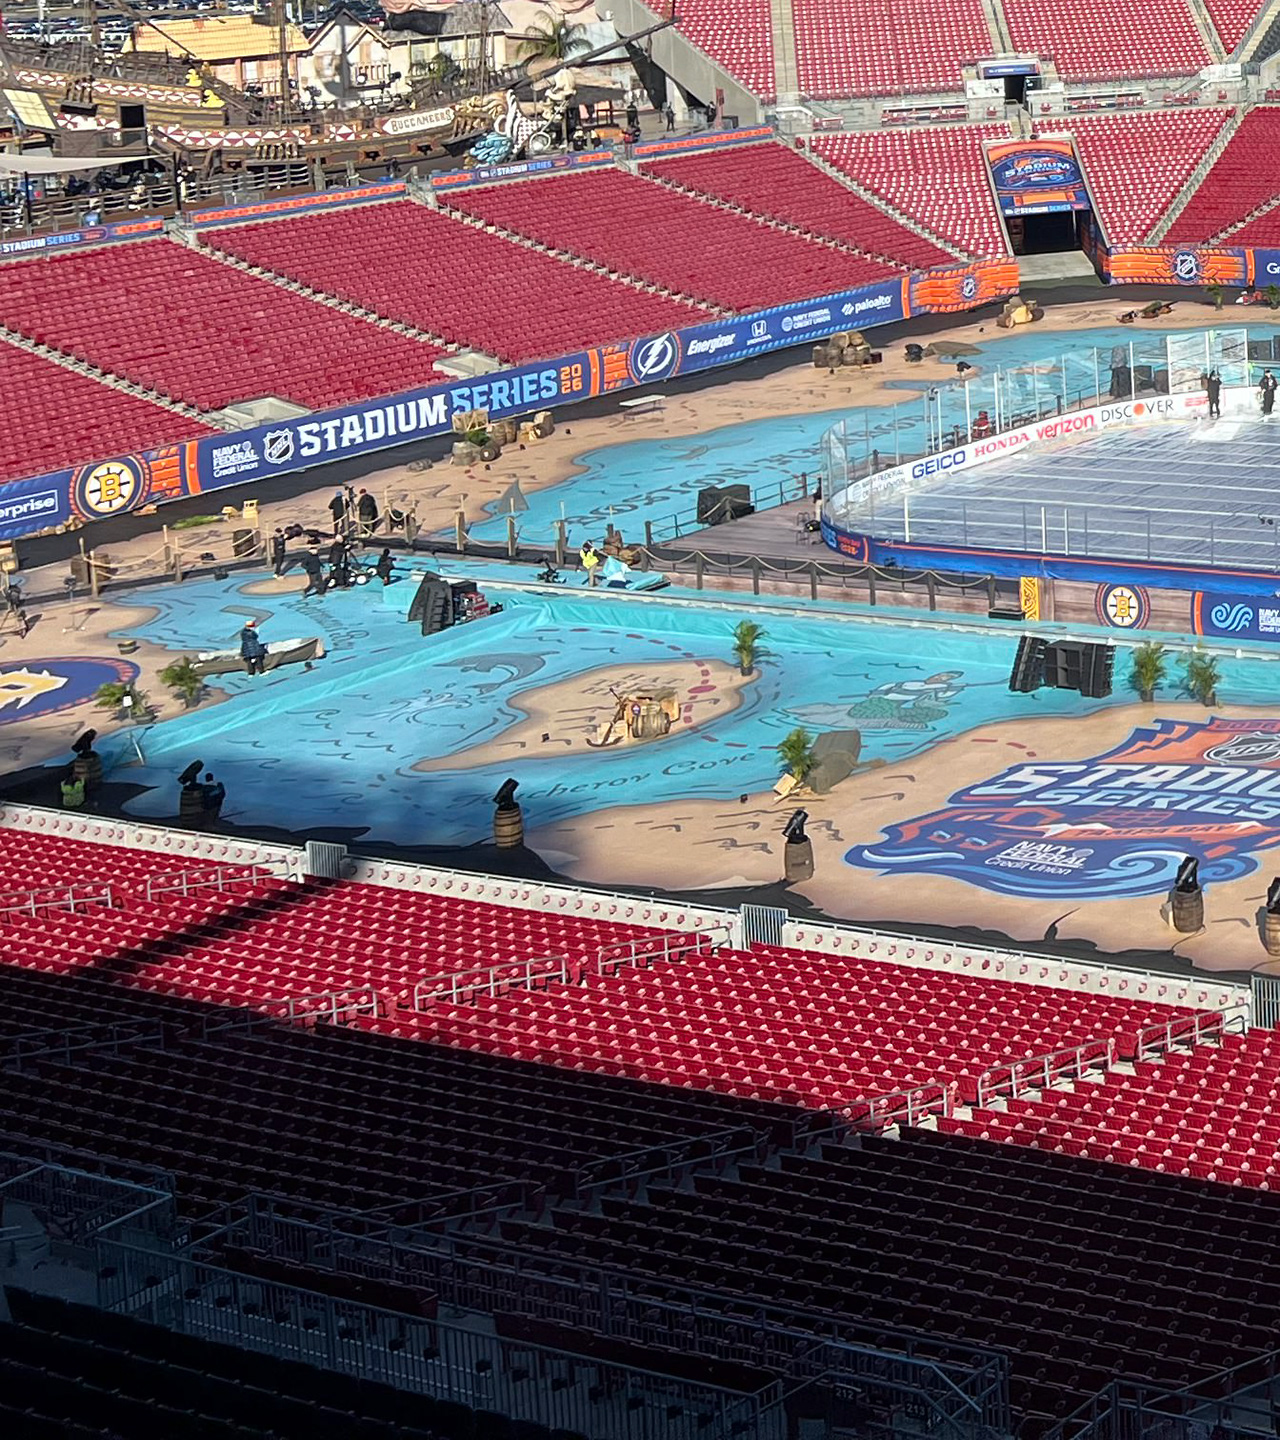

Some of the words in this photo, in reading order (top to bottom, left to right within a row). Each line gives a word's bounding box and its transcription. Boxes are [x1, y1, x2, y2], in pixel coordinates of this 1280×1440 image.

[391, 109, 451, 132] BUCCANEERS
[2, 238, 46, 253] STADIUM
[46, 233, 81, 245] SERIES
[687, 332, 735, 355] Energizer
[560, 363, 582, 379] 20
[450, 367, 557, 418] SERIES
[561, 379, 583, 395] 26
[1101, 399, 1174, 422] DISCOVER
[300, 394, 448, 457] STADIUM
[1036, 413, 1096, 441] verizon
[213, 445, 242, 460] NAVY
[974, 433, 1030, 458] HONDA
[214, 449, 259, 468] FEDERAL
[912, 450, 966, 479] GEICO
[453, 770, 651, 811] Kcherov
[662, 752, 756, 776] Cove
[1000, 846, 1086, 866] FEDERAL
[1014, 840, 1075, 855] NAVY
[985, 856, 1029, 870] Credit
[1030, 863, 1071, 876] Union
